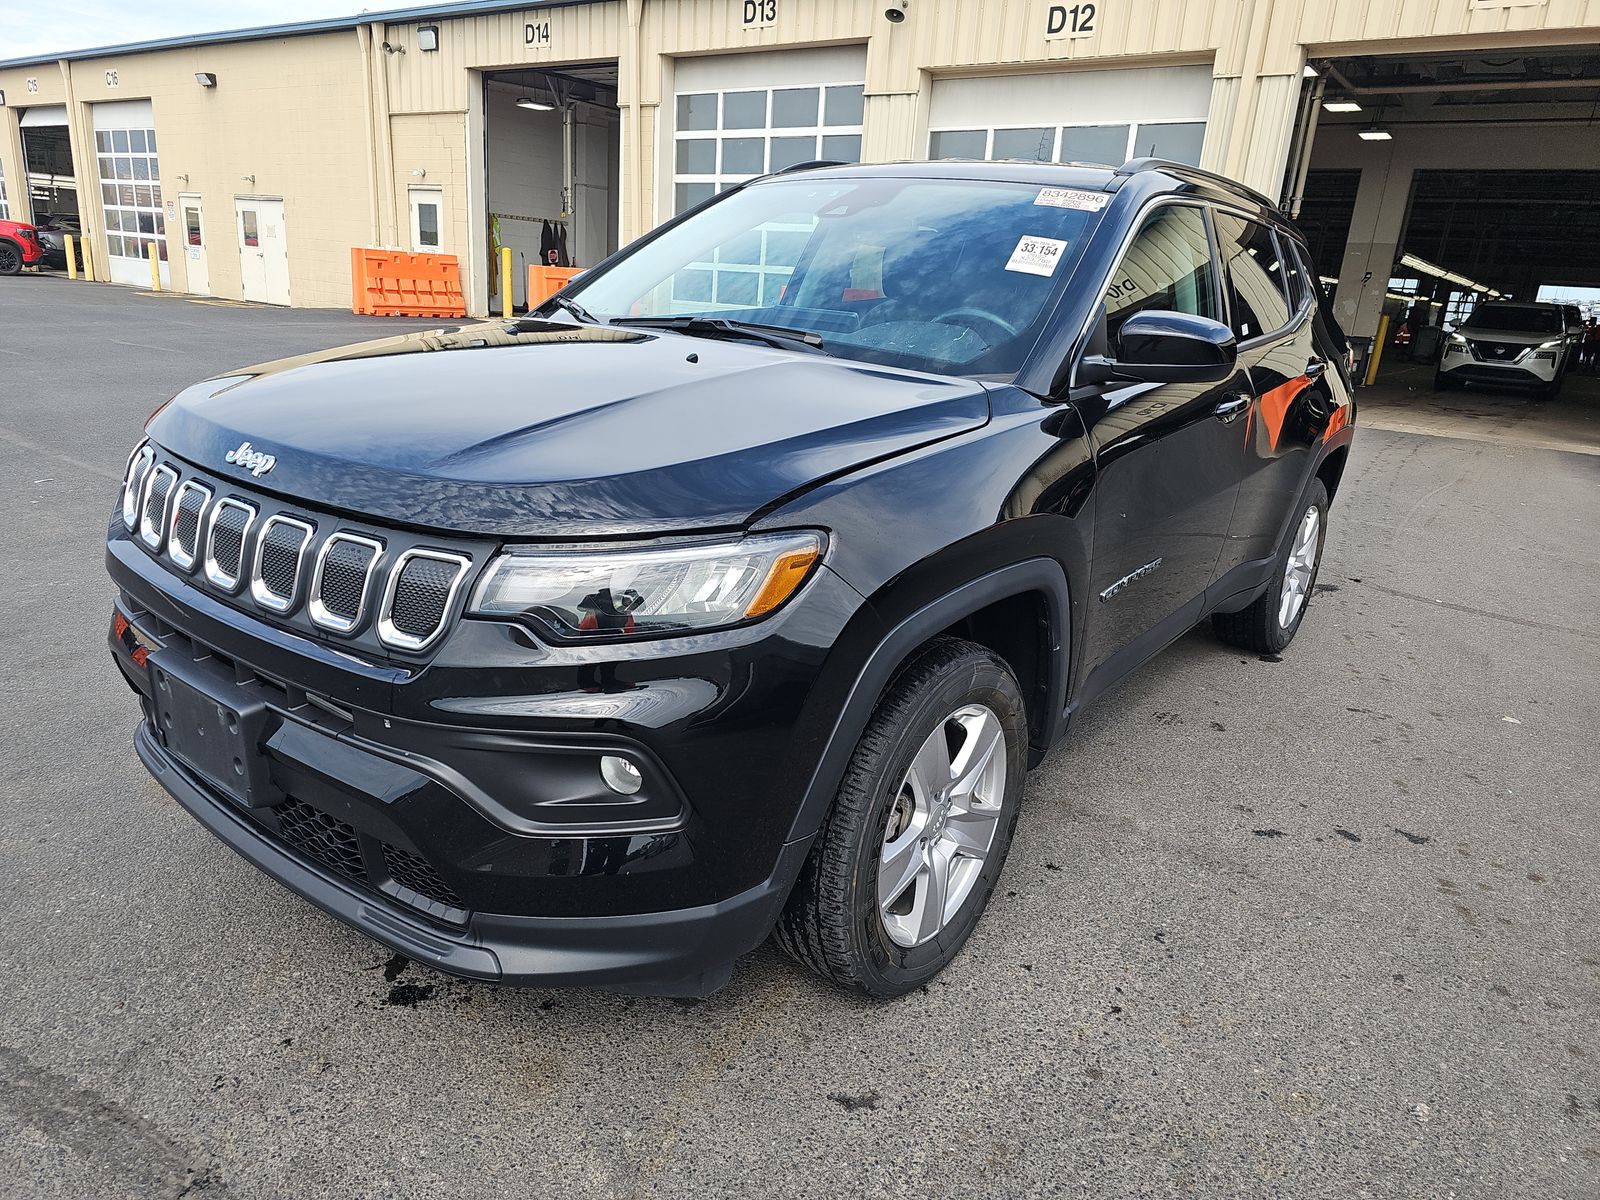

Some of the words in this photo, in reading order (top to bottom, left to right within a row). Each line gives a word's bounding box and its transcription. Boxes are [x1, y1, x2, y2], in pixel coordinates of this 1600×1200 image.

[743, 0, 777, 23] D13
[1047, 3, 1096, 34] D12
[525, 22, 550, 44] D14
[27, 79, 38, 93] C15
[105, 71, 119, 86] C16
[1041, 189, 1105, 203] 8342896
[1020, 242, 1059, 257] 33:154
[225, 441, 276, 478] Jeep
